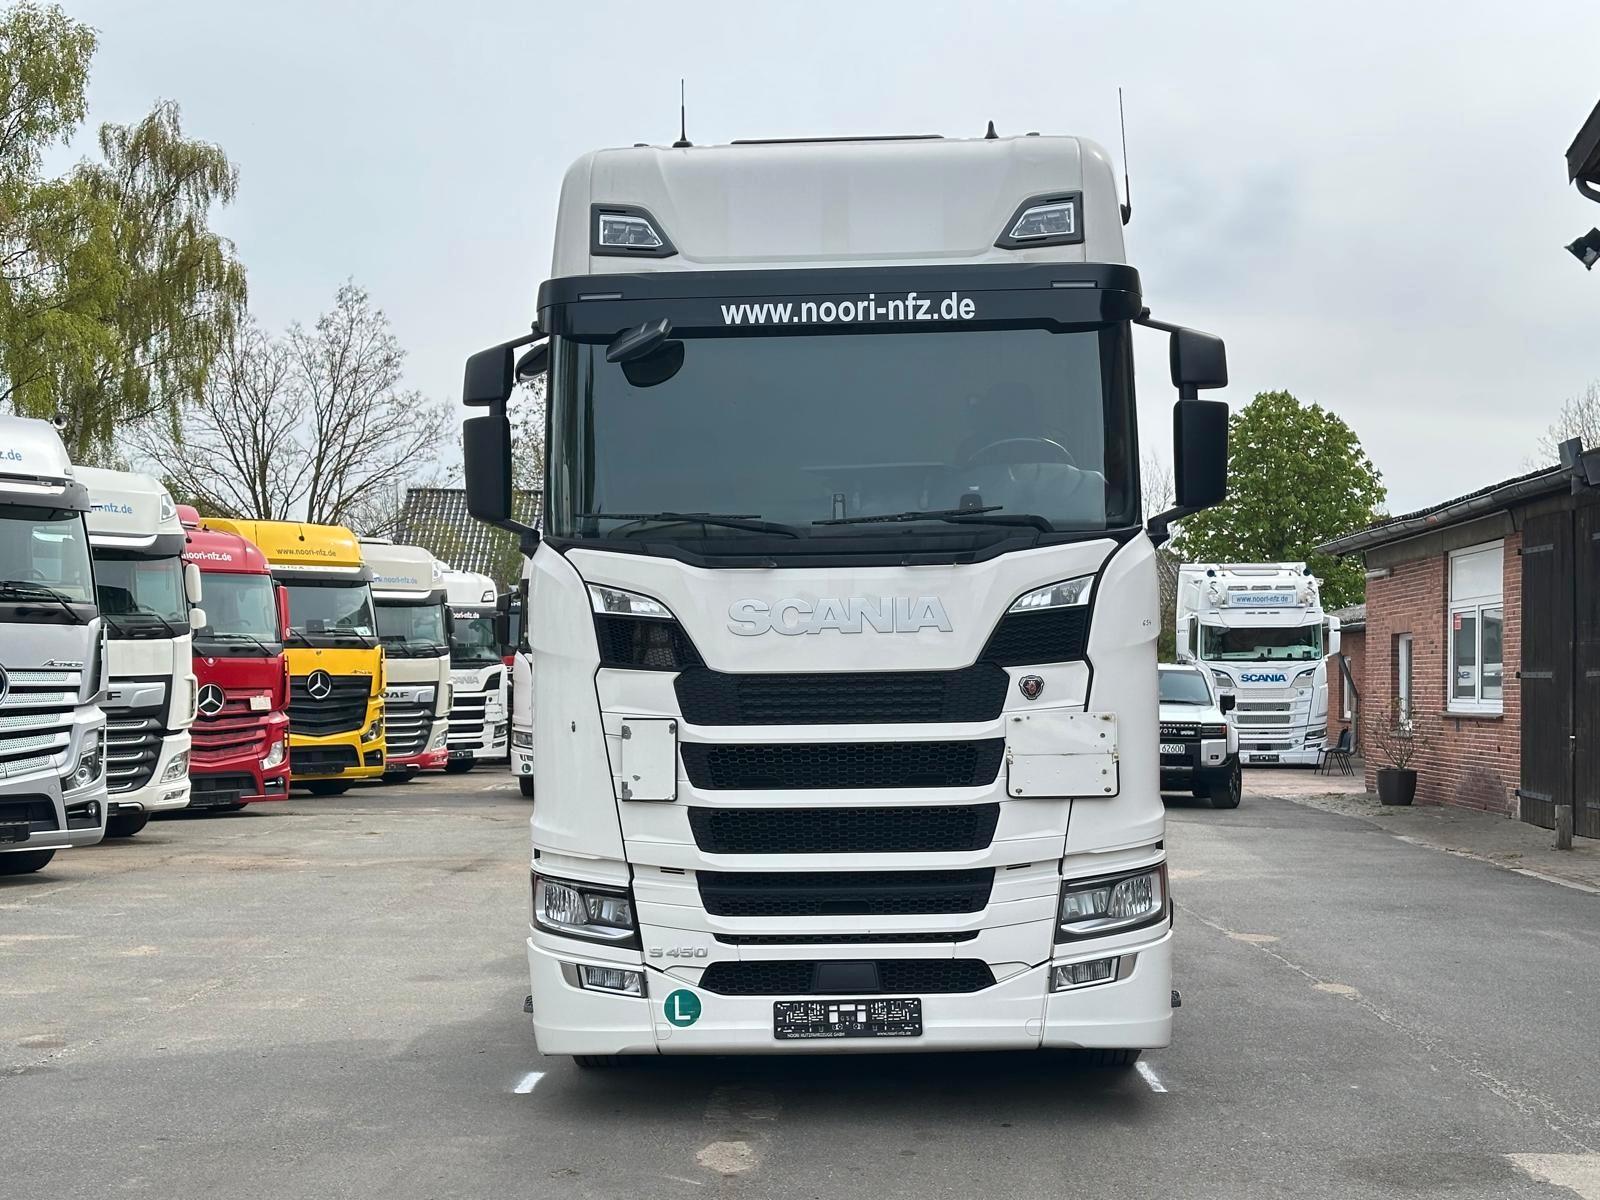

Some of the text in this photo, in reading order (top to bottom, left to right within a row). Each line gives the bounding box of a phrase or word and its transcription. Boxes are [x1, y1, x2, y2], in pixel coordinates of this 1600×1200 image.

[721, 292, 976, 325] www.noori-nfz.de
[727, 595, 954, 637] SCANIA
[1240, 673, 1287, 682] SCANIA
[1161, 744, 1185, 753] 62600
[649, 947, 709, 959] S 450
[674, 995, 691, 1020] L
